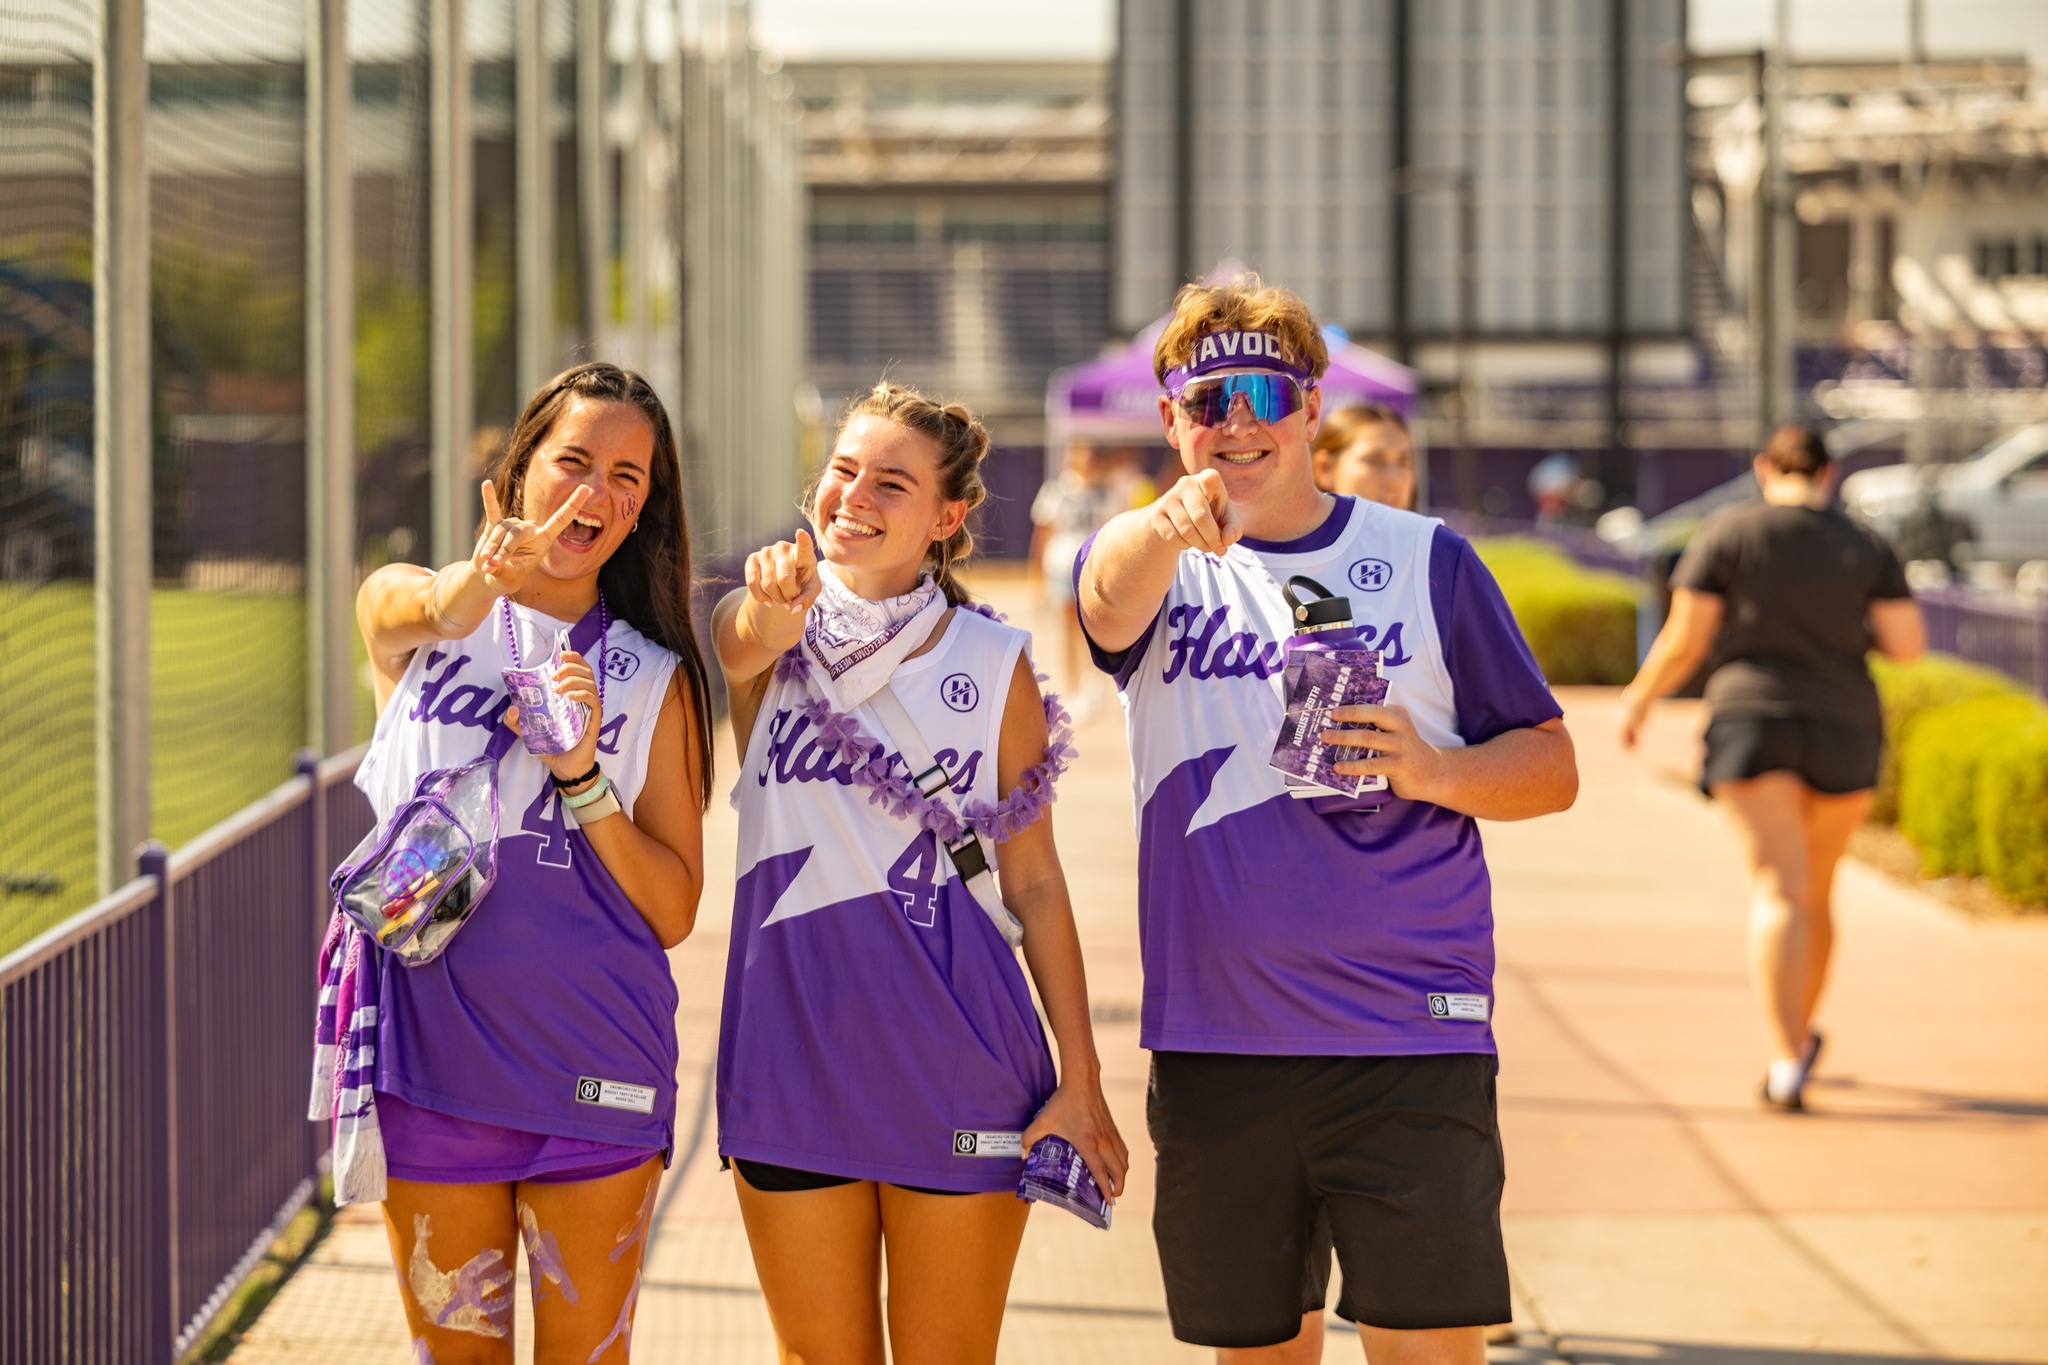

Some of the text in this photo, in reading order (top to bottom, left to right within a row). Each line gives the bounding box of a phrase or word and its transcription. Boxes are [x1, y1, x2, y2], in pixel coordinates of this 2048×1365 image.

[835, 634, 888, 674] WELCOME WEEK
[1292, 711, 1310, 747] AUGUST
[1304, 685, 1321, 711] 29TH
[520, 769, 572, 869] 4
[887, 828, 938, 928] 4
